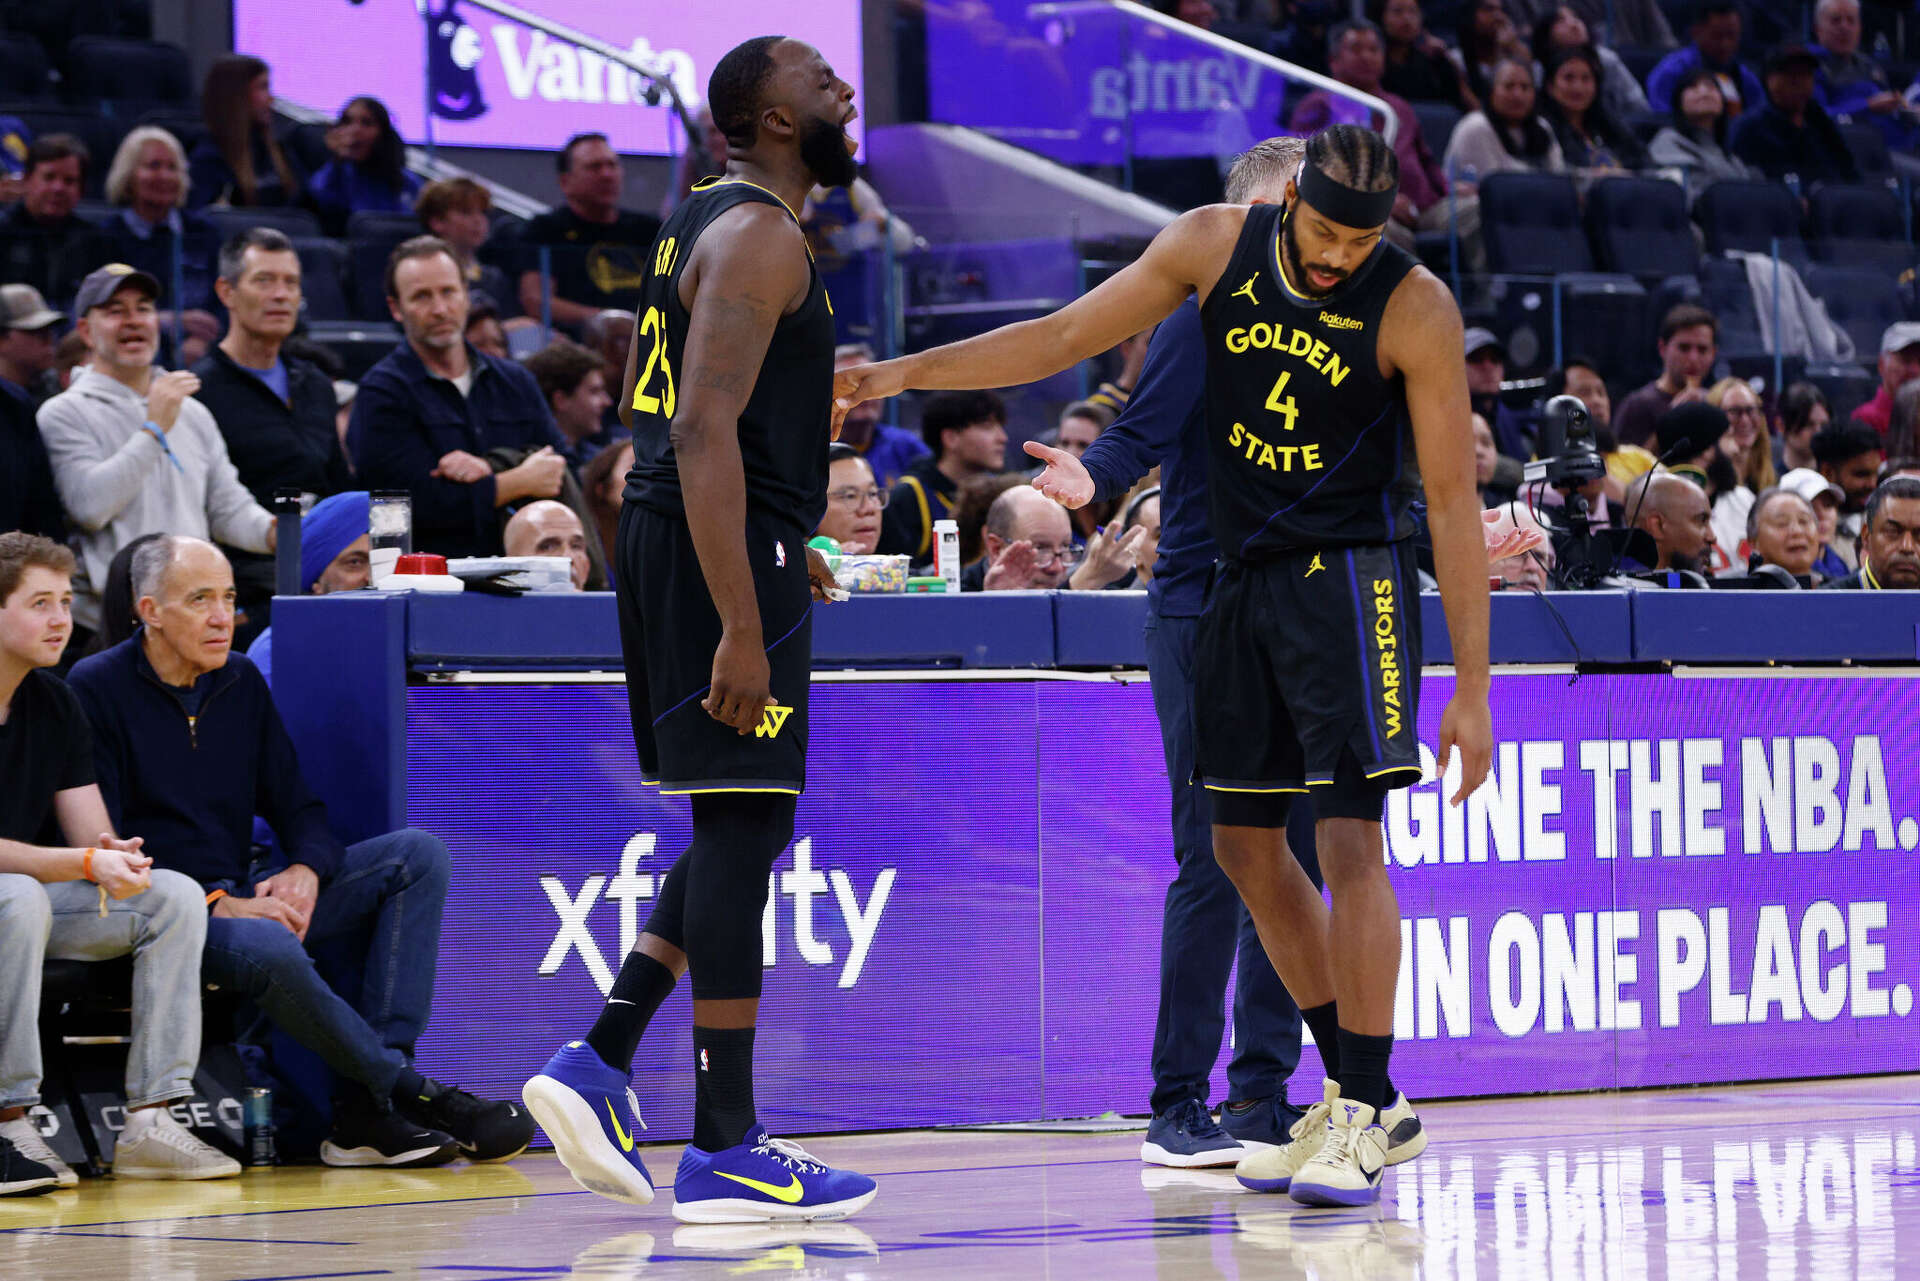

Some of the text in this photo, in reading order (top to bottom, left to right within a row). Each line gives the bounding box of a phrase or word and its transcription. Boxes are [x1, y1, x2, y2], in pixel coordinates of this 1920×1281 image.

[491, 24, 701, 107] Vanta
[1225, 322, 1351, 387] GOLDEN
[1319, 310, 1364, 331] Rakuten
[1264, 370, 1299, 431] 4
[1228, 422, 1324, 472] STATE
[1373, 578, 1401, 739] WARRIORS
[1381, 734, 1919, 867] GINE THE NBA.
[1488, 910, 1643, 1038] ONE
[1656, 900, 1914, 1027] PLACE.
